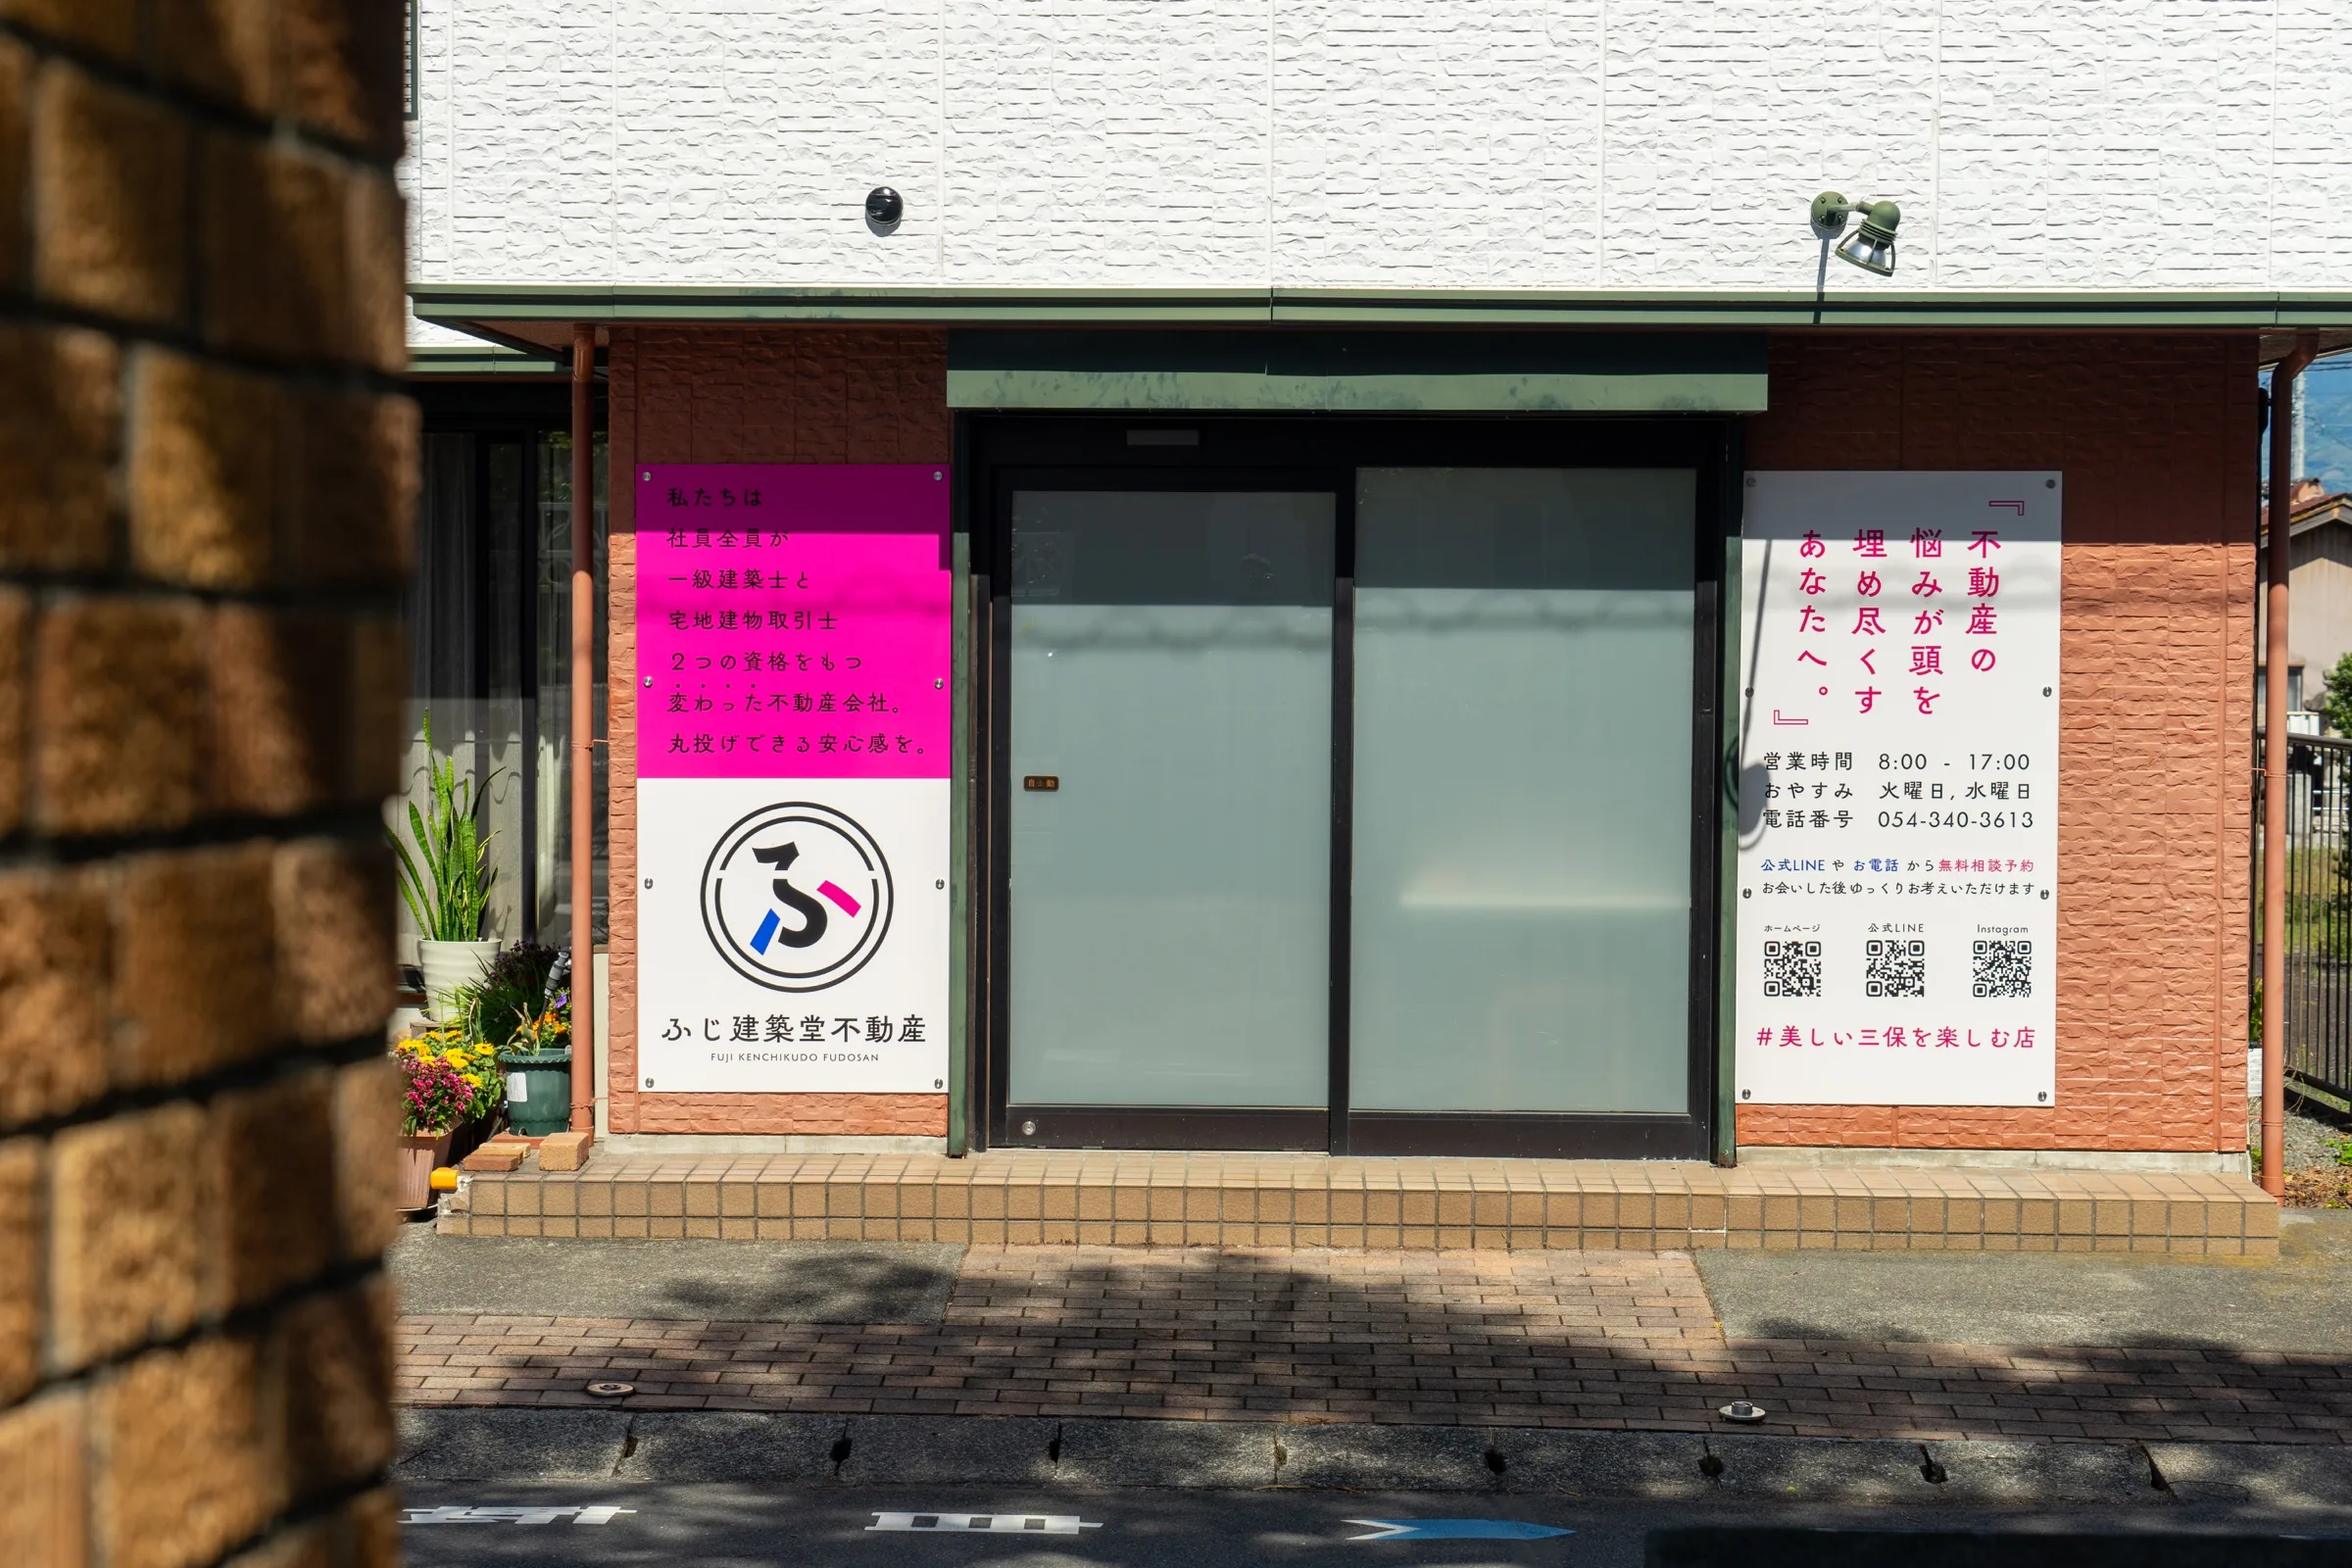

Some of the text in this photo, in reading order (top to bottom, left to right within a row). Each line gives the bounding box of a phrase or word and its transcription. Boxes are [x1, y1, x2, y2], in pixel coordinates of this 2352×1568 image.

[665, 487, 763, 508] 私たちは
[665, 528, 790, 549] 社員全員が
[667, 567, 808, 590] 一級建築士と
[668, 609, 838, 631] 宅地建物取引士
[1851, 528, 1887, 714] 埋め尽くす
[1908, 527, 1944, 714] 悩みが頭を
[671, 650, 861, 672] 2つの資格をもつ
[666, 691, 899, 714] 変わった不動産会社。
[667, 732, 924, 755] 丸投げできる安心感を。
[1763, 751, 1853, 771] 営業時間
[1879, 753, 1928, 770] 8:00
[1969, 753, 2030, 770] 17:00
[1764, 781, 1854, 799] おやすみ
[1762, 808, 2034, 829] 電話番号 054-340-3613
[1763, 923, 1821, 933] ホームページ
[1867, 922, 1925, 933] 公式LINE
[1977, 923, 2029, 937] Instagram
[661, 1013, 926, 1044] ふじ建築堂不動産
[1756, 1024, 2035, 1049] #美しい三保を楽しむ店
[710, 1053, 879, 1063] FUJI KENCHIKUDO FUDOSAN
